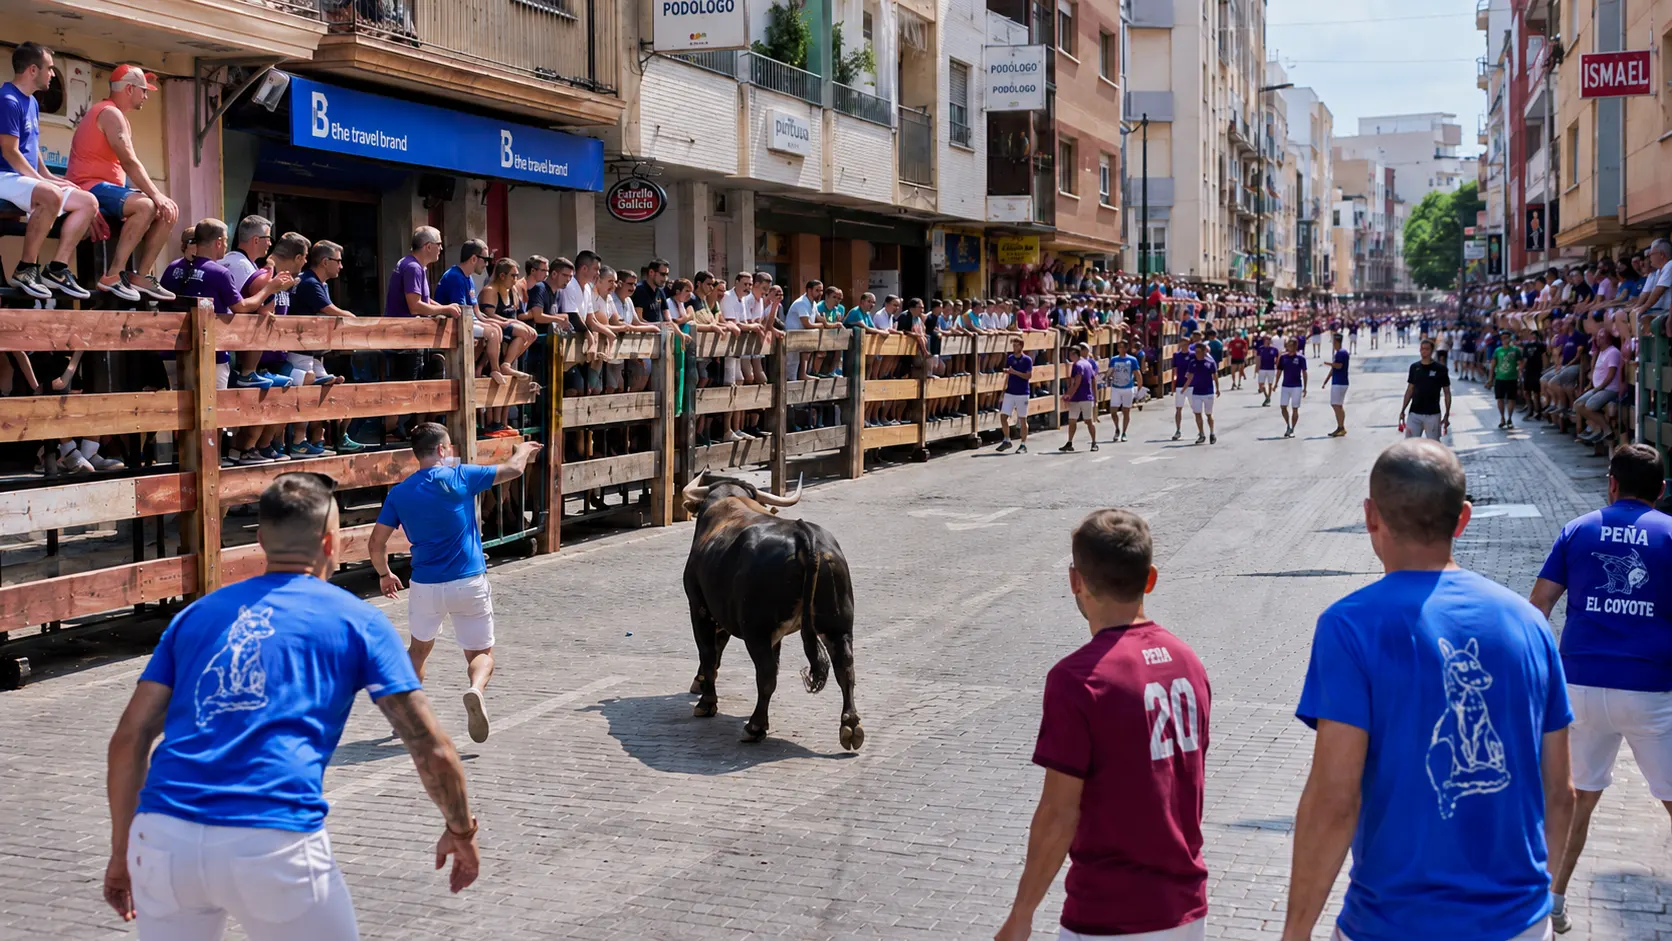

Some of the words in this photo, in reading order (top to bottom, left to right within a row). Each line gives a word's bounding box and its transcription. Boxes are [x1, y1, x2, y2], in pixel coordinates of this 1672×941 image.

[1584, 60, 1649, 89] ISMAEL
[311, 91, 330, 138] B
[351, 126, 380, 147] travel
[380, 131, 408, 152] brand
[500, 129, 514, 169] B
[514, 154, 528, 170] the
[527, 156, 548, 174] travel
[548, 159, 568, 177] brand
[1600, 524, 1649, 547] PEÑA
[1585, 595, 1602, 613] EL
[1604, 597, 1655, 618] COYOTE
[1144, 677, 1199, 761] 20
